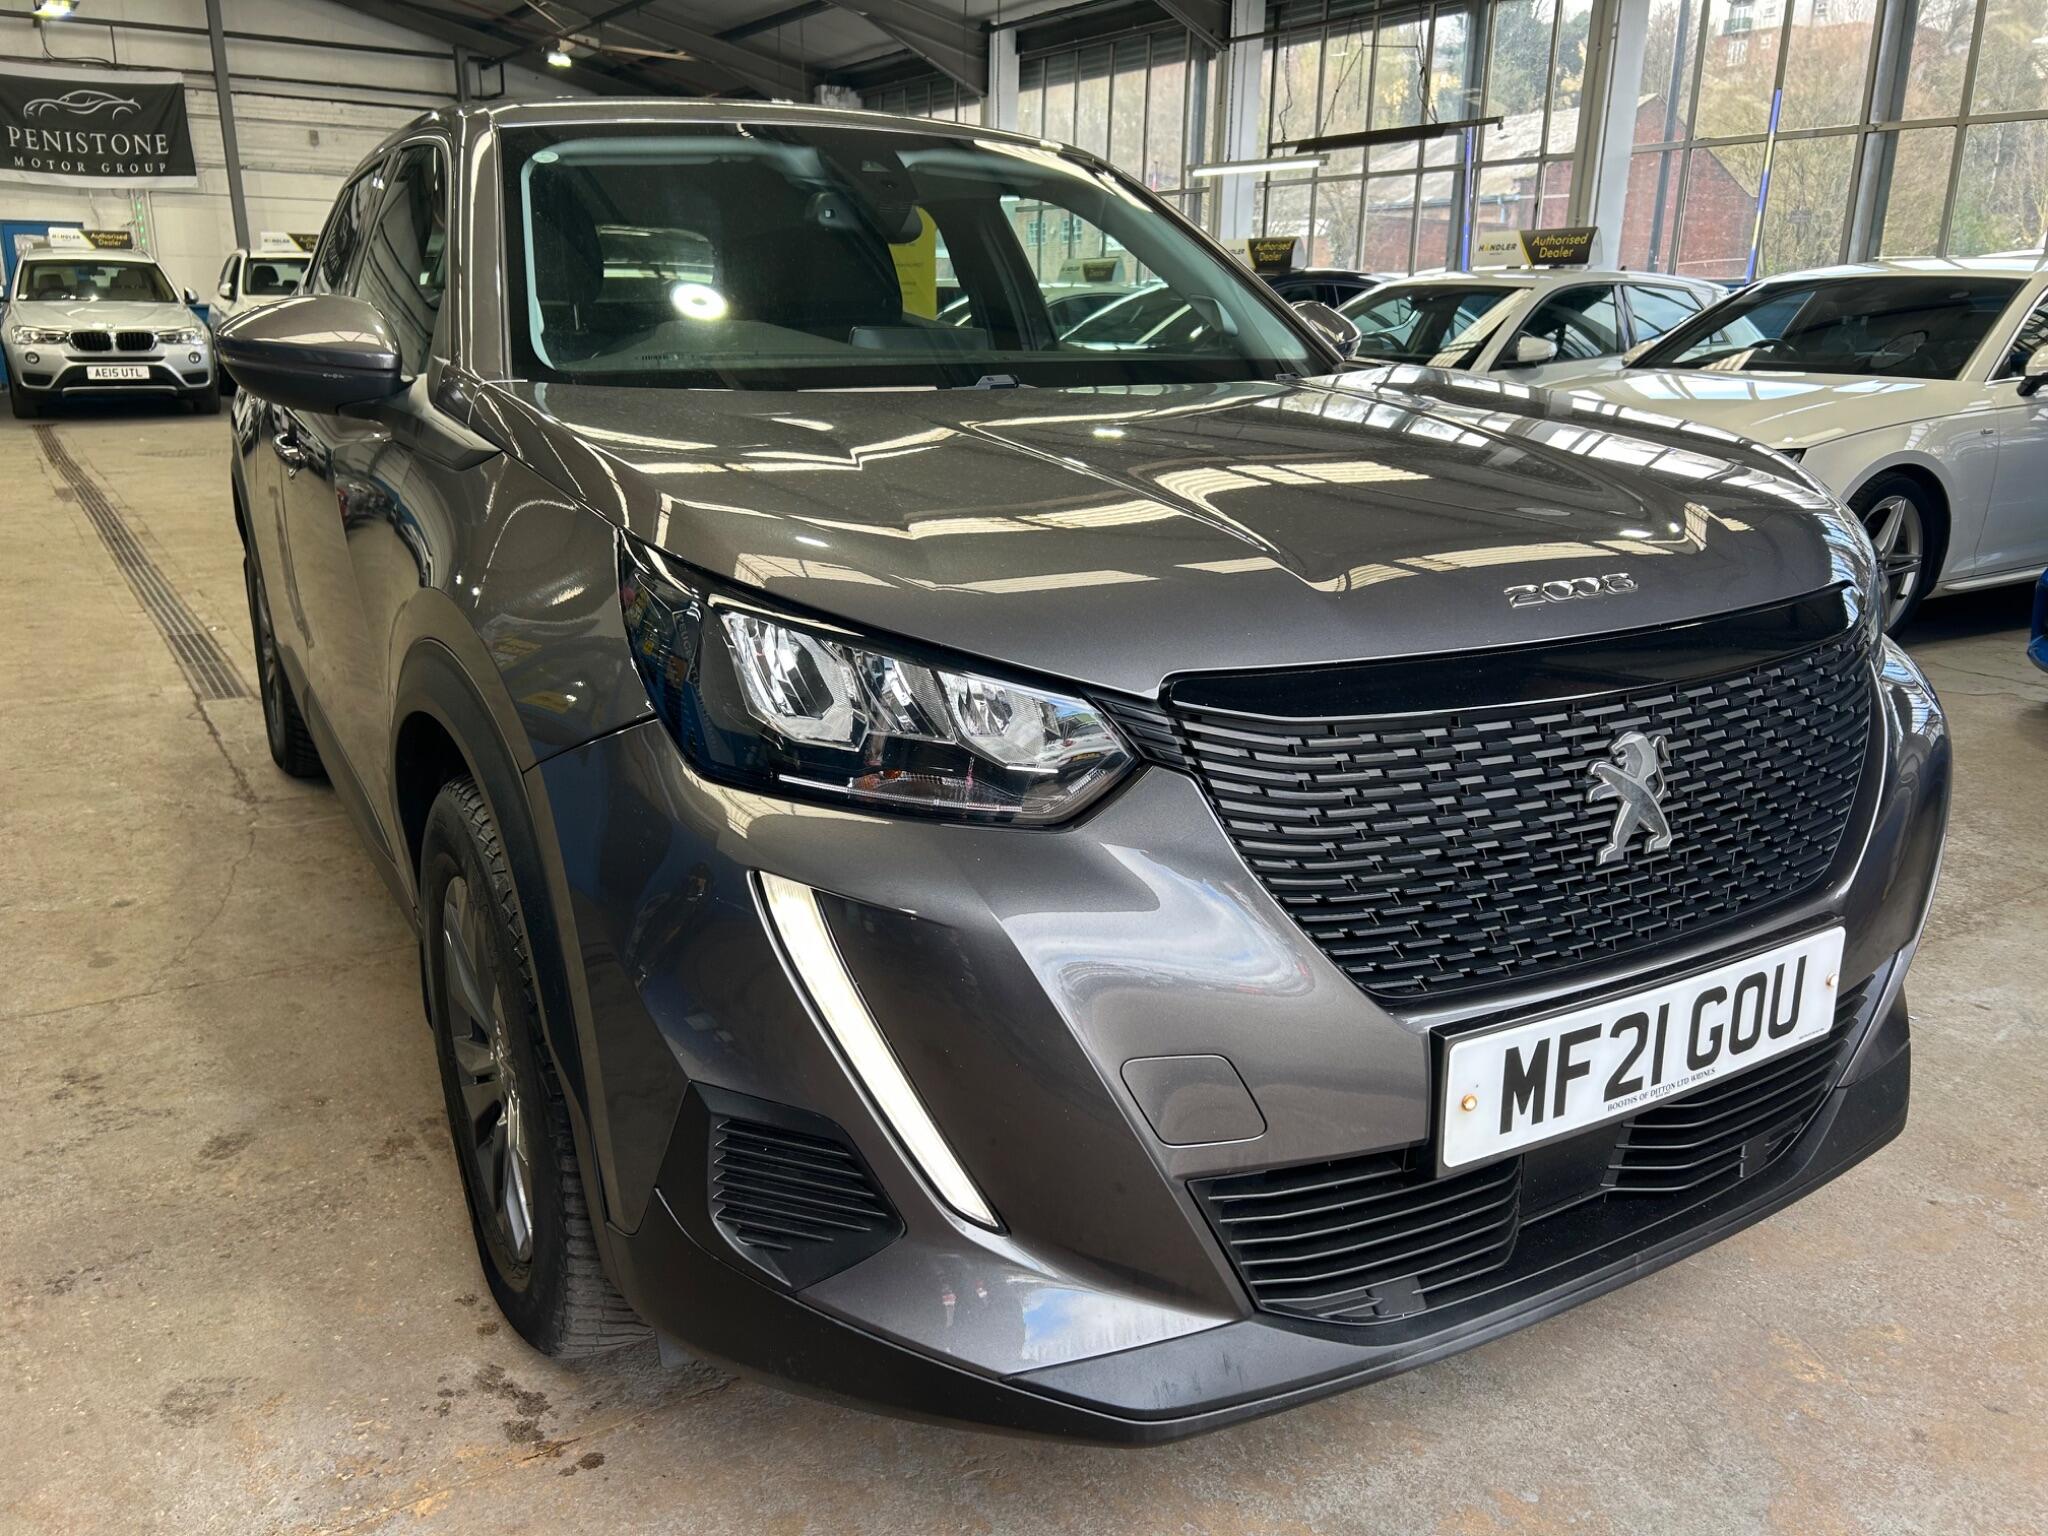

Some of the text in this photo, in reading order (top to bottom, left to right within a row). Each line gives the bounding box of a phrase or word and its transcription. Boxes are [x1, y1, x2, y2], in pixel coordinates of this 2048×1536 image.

[6, 125, 169, 155] PENISTONE
[14, 156, 167, 174] MOTOR GROUP
[90, 232, 128, 241] Authorised
[1532, 233, 1590, 247] Authorised
[1538, 247, 1575, 258] Dealer
[95, 368, 142, 378] AE15 UTL
[1504, 572, 1639, 608] 2008
[1500, 955, 1808, 1135] MF21 GOU
[1607, 1094, 1638, 1112] BOOTHS
[1639, 1090, 1649, 1102] OF
[1650, 1083, 1676, 1097] DITTON
[1677, 1076, 1690, 1087] LTD
